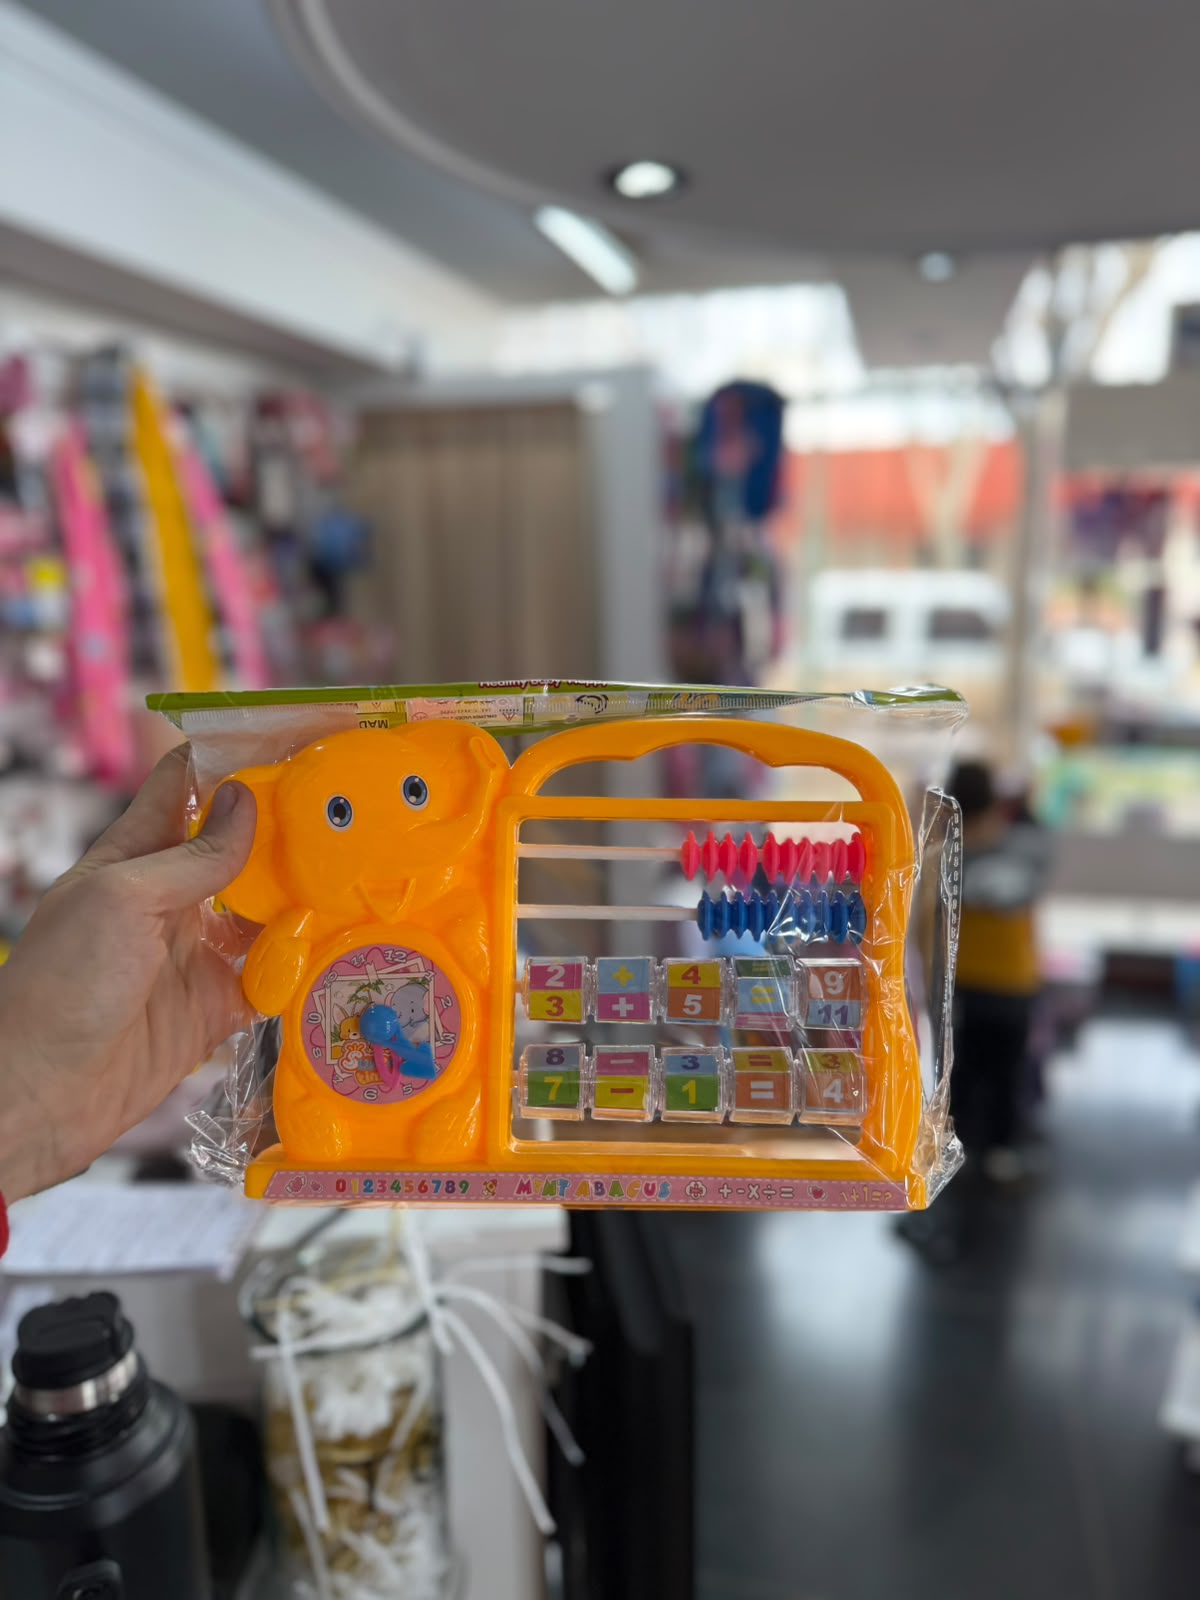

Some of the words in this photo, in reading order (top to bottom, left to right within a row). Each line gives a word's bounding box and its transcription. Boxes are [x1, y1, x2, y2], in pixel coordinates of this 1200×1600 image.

[351, 953, 367, 967] 11
[384, 949, 408, 963] 12
[323, 971, 338, 988] 10
[545, 965, 565, 987] 2
[681, 966, 701, 984] 4
[823, 971, 844, 995] 9
[440, 996, 453, 1009] 2
[545, 996, 564, 1017] 3
[682, 994, 702, 1015] 5
[818, 1004, 848, 1025] 11
[307, 1012, 322, 1024] 9
[441, 1033, 456, 1045] 3
[545, 1048, 565, 1065] 8
[681, 1055, 700, 1070] 3
[822, 1053, 841, 1069] 3
[363, 1088, 378, 1100] 6
[402, 1084, 414, 1095] 5
[544, 1076, 563, 1101] 7
[681, 1079, 697, 1104] 1
[823, 1078, 843, 1103] 4
[515, 1175, 570, 1198] MINT
[574, 1179, 671, 1199] ABACUS
